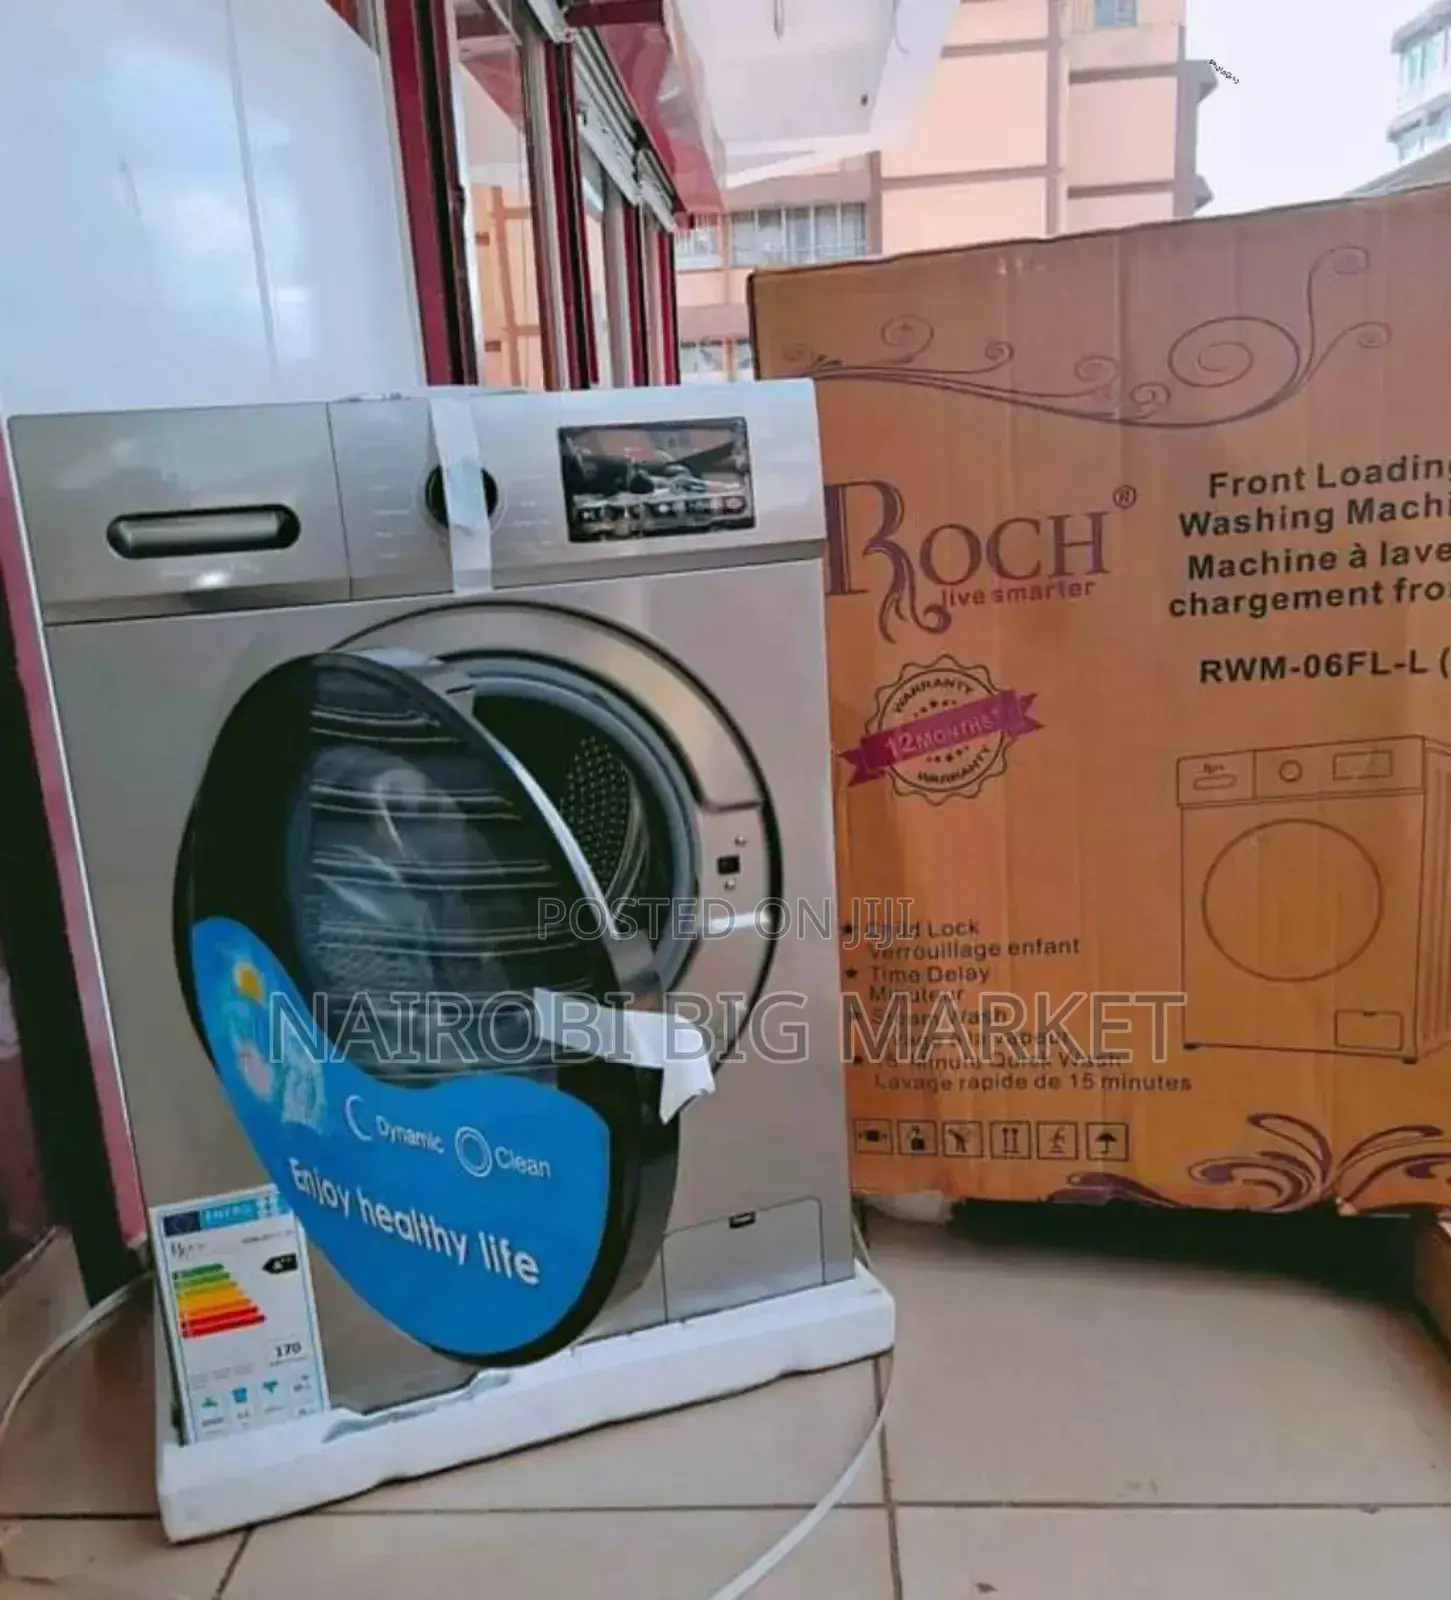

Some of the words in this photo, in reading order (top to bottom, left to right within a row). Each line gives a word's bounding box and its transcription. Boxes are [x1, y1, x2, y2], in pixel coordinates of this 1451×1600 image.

[1209, 465, 1306, 498] Front
[1317, 454, 1451, 488] Loadin
[1178, 505, 1334, 538] Washing
[1188, 549, 1338, 581] Machine
[1348, 543, 1367, 569] à
[941, 586, 986, 609] live
[995, 579, 1097, 603] smarter
[1169, 580, 1384, 619] chargement
[1394, 576, 1451, 604] fro
[1200, 649, 1430, 685] RWM-06FL-L
[928, 918, 980, 937] Lock
[1008, 937, 1081, 957] enfant
[870, 964, 921, 983] Time
[927, 963, 990, 985] Delay
[874, 1074, 953, 1093] Lavage
[959, 1072, 1027, 1093] rapide
[1033, 1071, 1061, 1090] de
[1071, 1072, 1094, 1090] 15
[1101, 1071, 1192, 1091] minutes
[375, 1115, 445, 1154] Dynamic
[494, 1146, 552, 1179] Clean
[289, 1156, 350, 1219] Enjoy
[356, 1184, 468, 1266] healthy
[478, 1230, 540, 1286] life
[275, 1341, 303, 1358] 170
